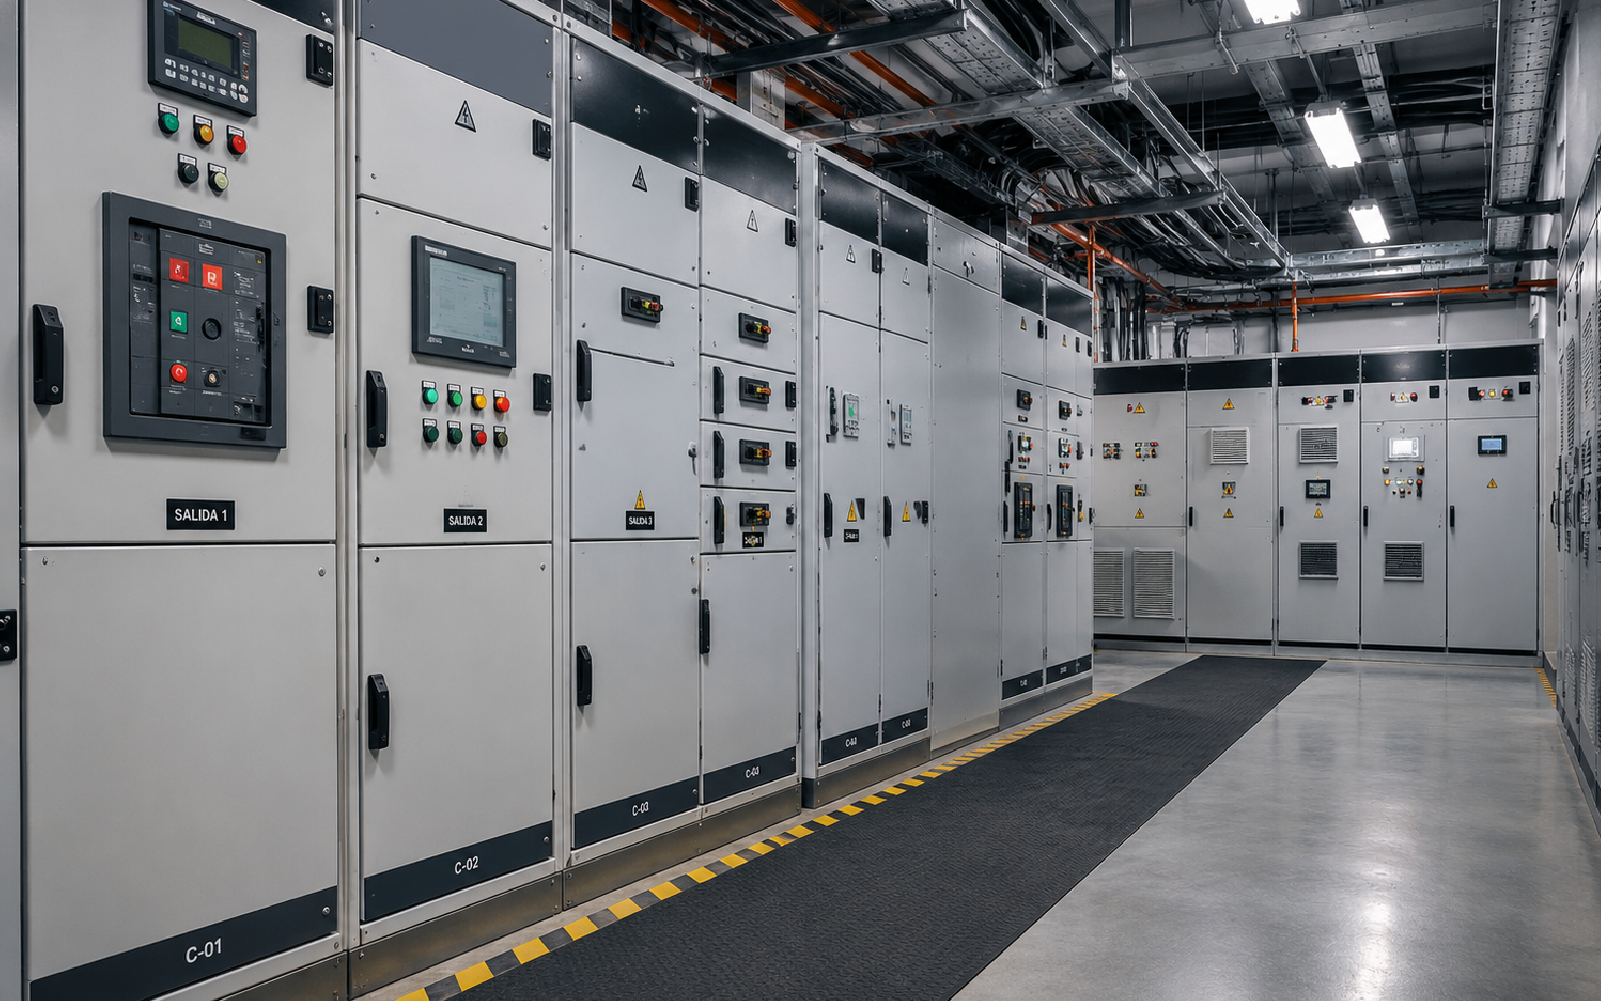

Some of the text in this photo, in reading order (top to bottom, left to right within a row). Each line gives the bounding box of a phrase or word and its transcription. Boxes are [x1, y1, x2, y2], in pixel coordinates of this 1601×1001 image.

[174, 508, 228, 522] SALIDA 1
[449, 515, 484, 526] SALIDA 2
[454, 855, 479, 875] C-02
[185, 937, 222, 963] C-01
